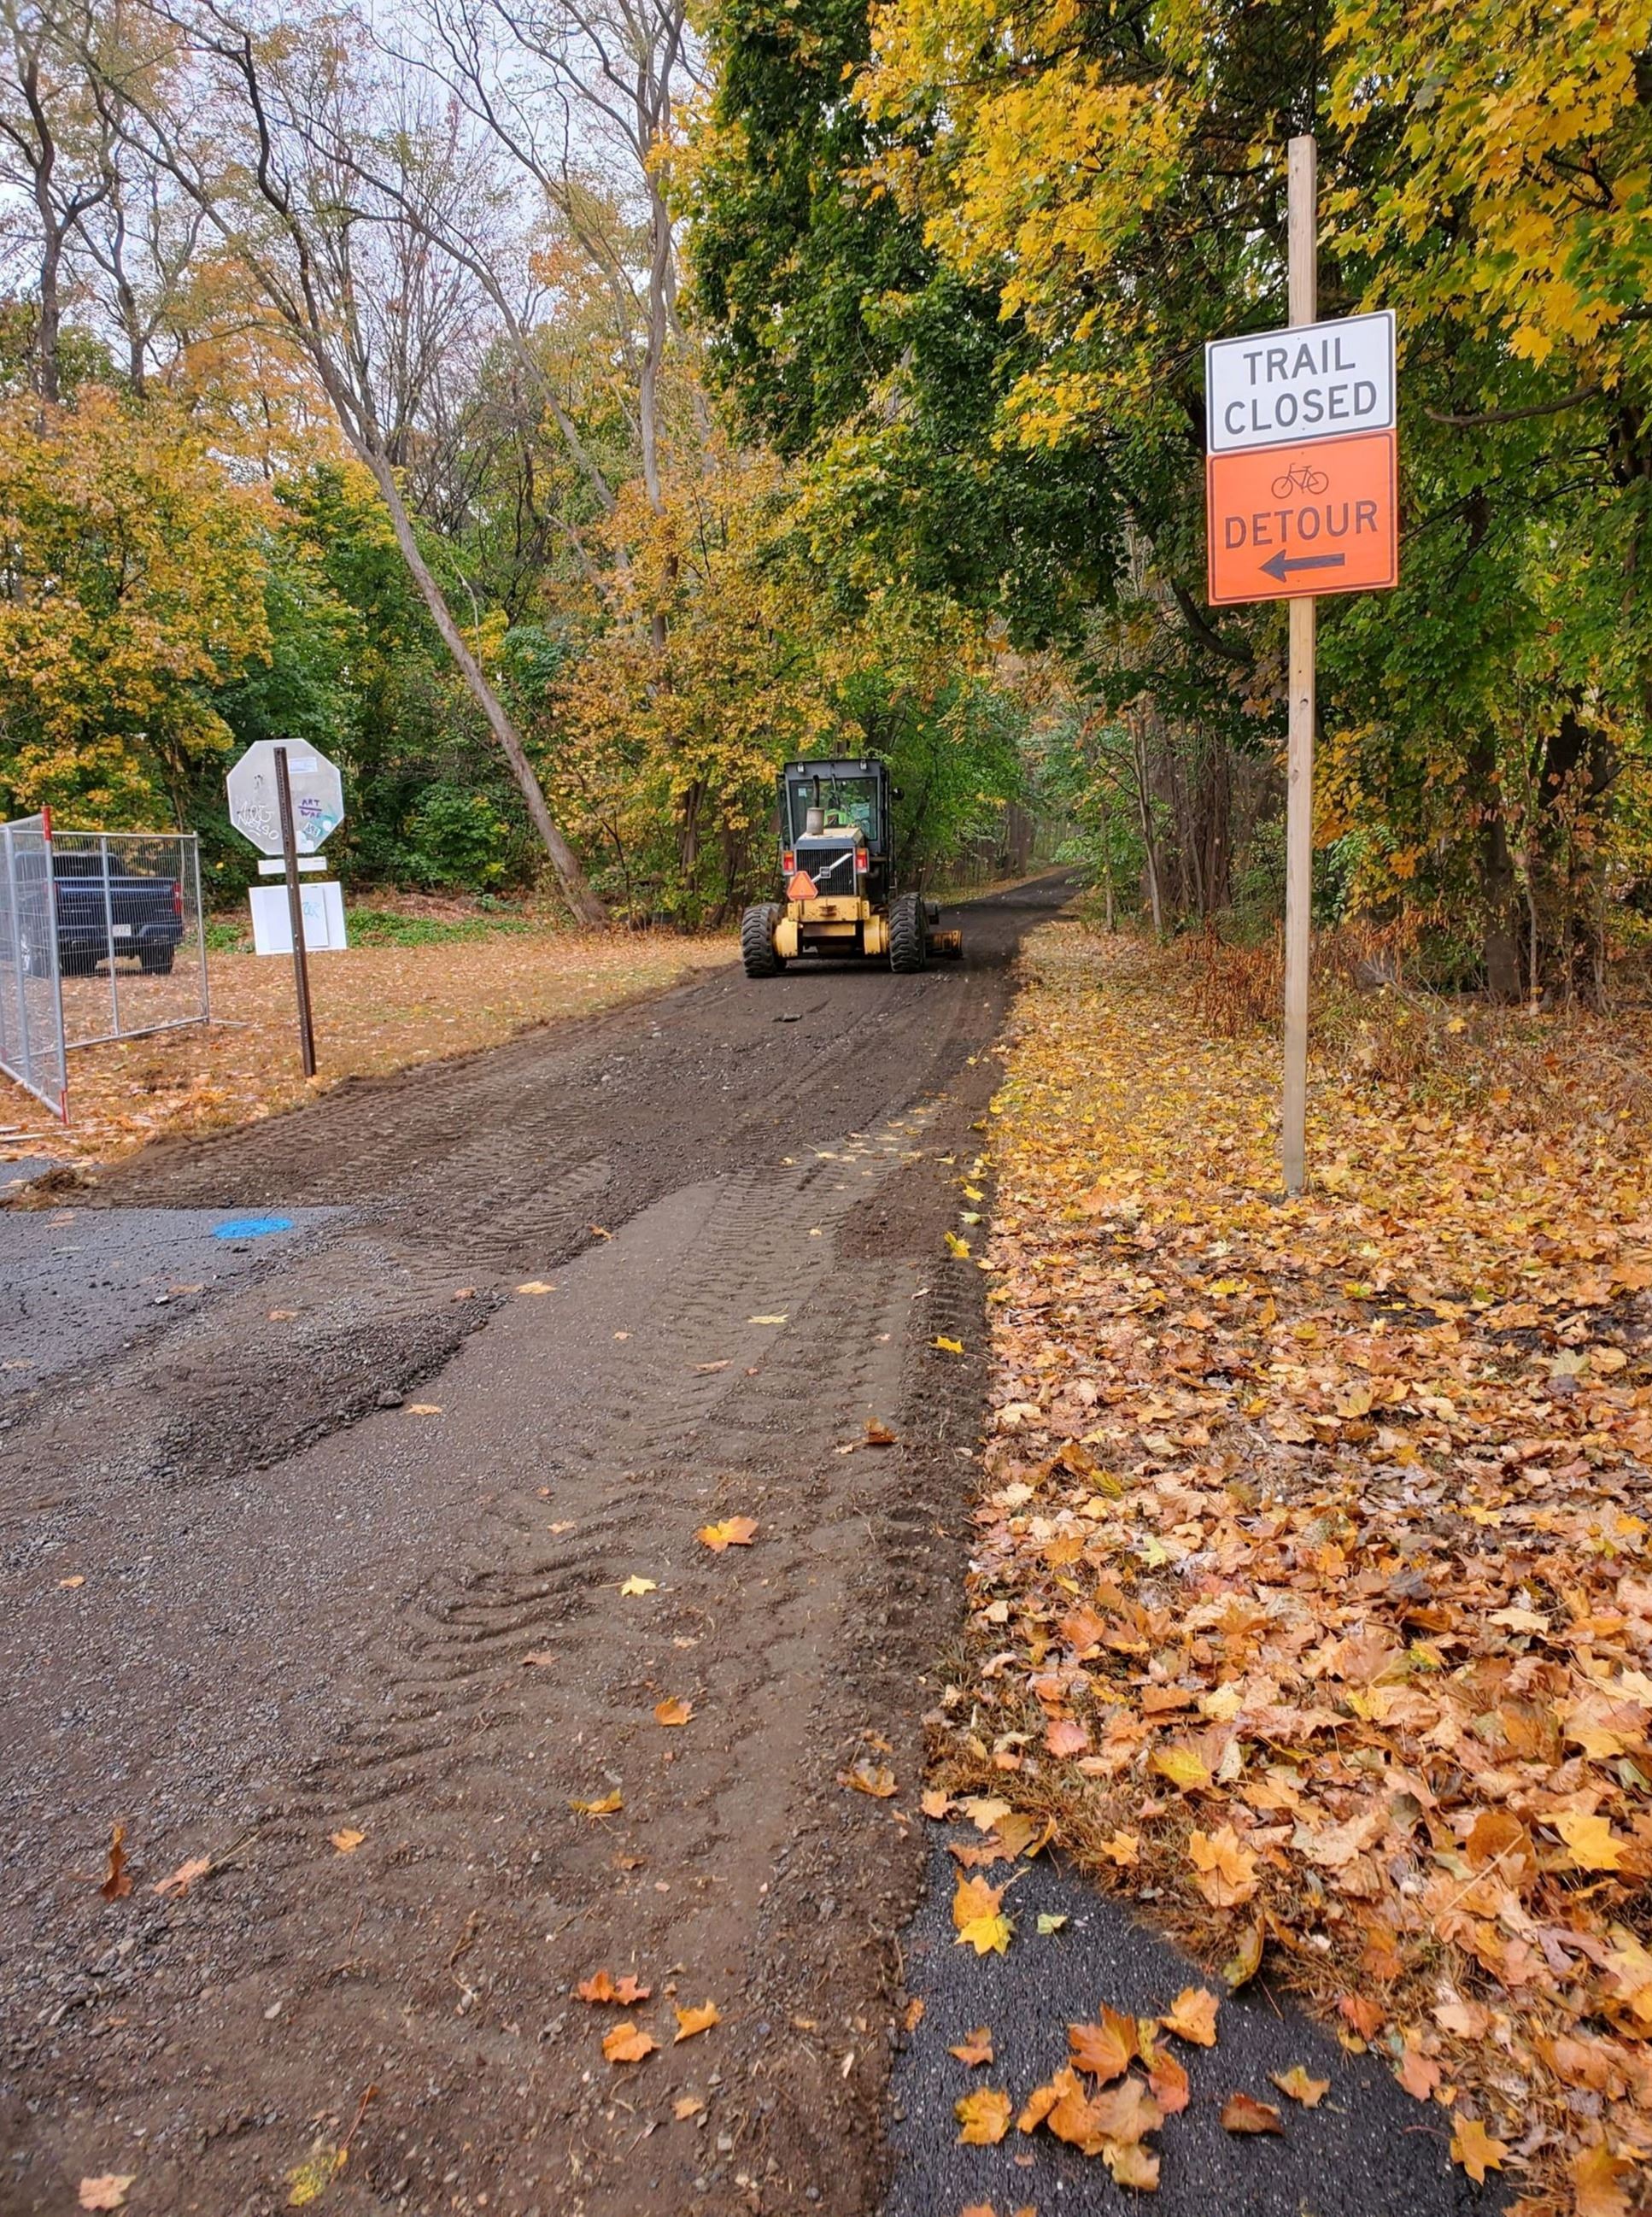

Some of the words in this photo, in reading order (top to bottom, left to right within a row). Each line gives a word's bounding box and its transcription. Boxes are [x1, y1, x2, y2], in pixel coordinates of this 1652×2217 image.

[1243, 337, 1356, 385] TRAIL
[1224, 381, 1378, 435] CLOSED
[1224, 500, 1378, 549] DETOUR
[301, 798, 320, 806] ART
